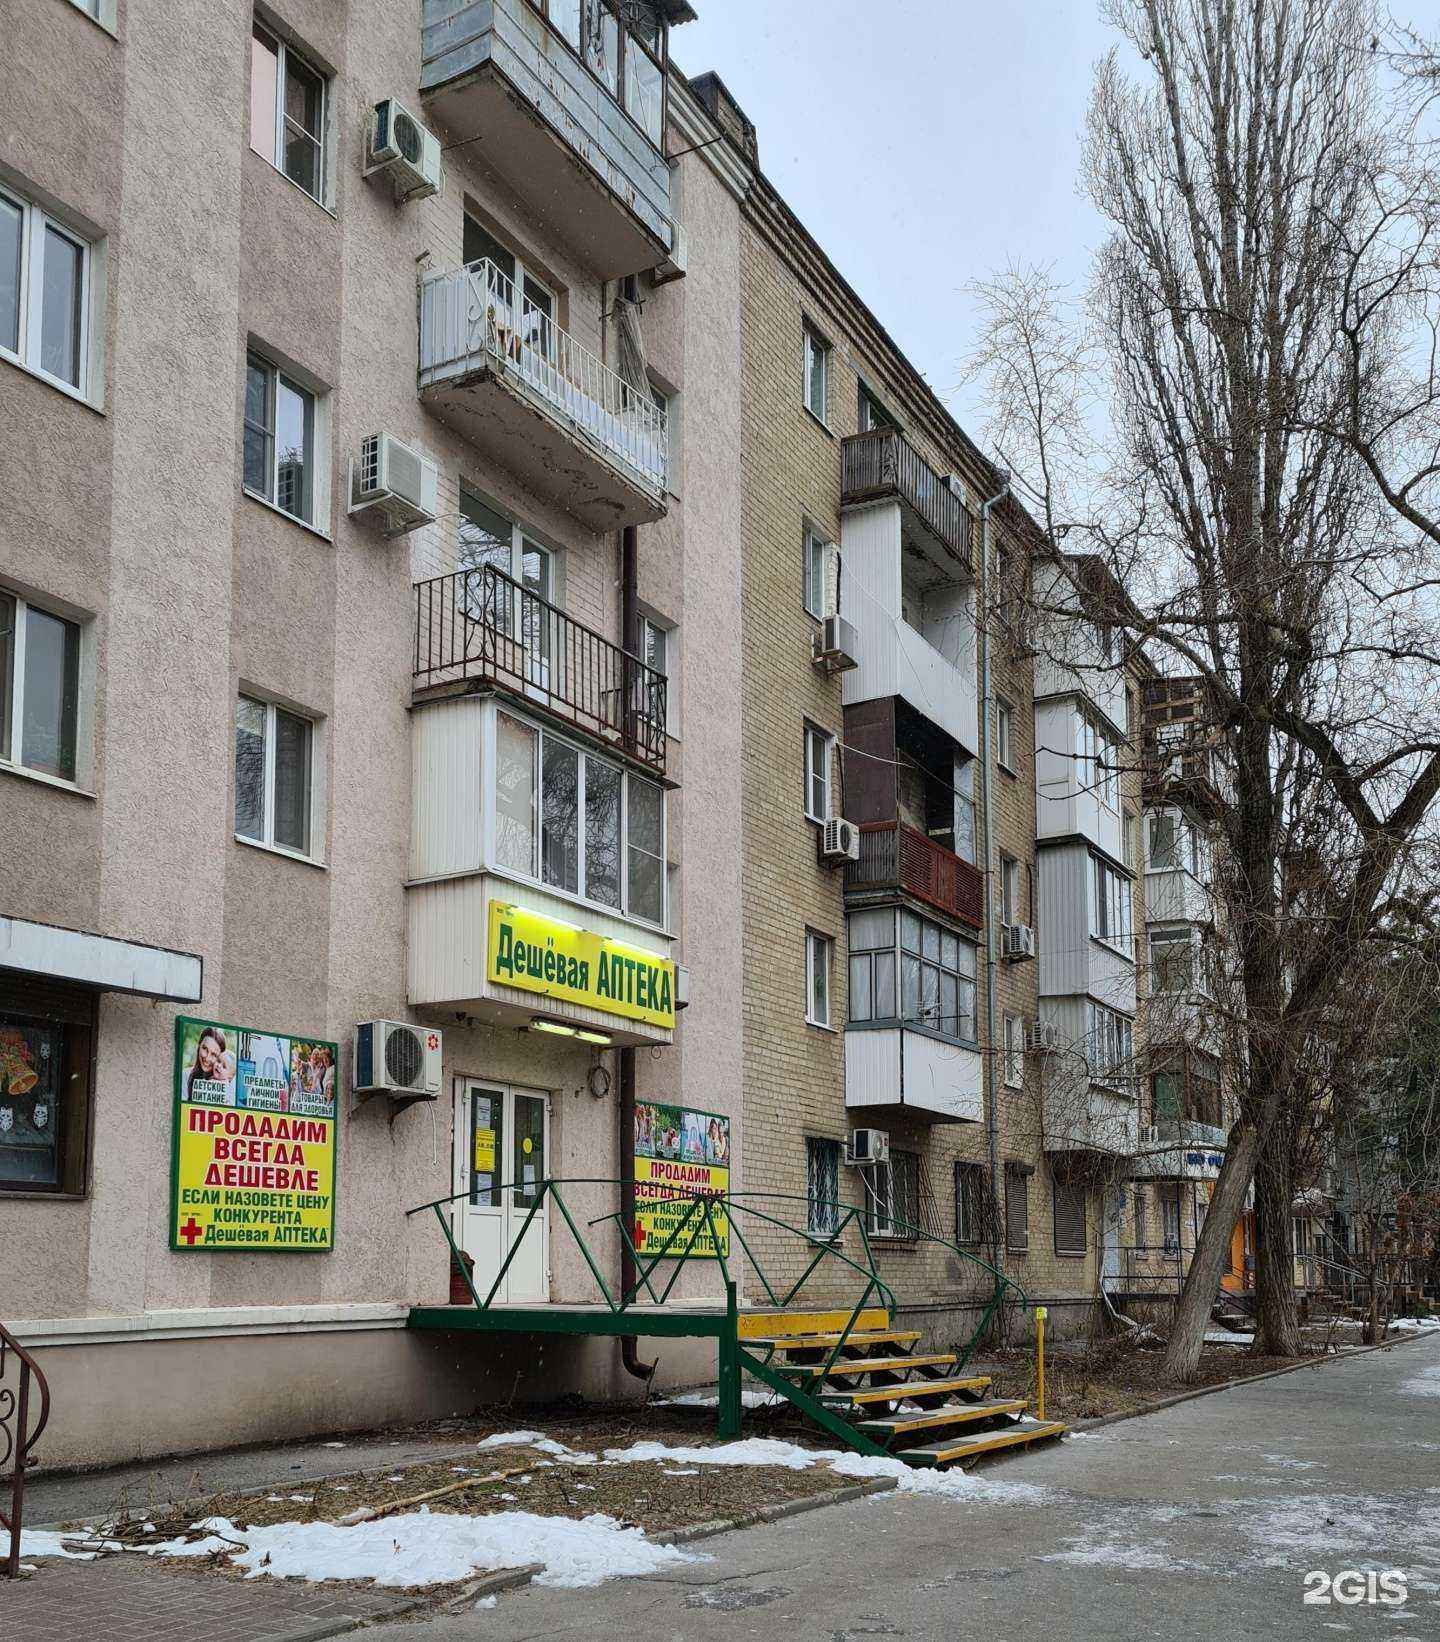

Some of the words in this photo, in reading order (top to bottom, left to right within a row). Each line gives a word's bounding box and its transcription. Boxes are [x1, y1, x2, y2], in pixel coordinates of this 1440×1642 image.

[496, 922, 590, 992] Дешёвая
[596, 950, 672, 1015] АПТЕКА
[193, 1079, 226, 1093] ДЕТСКОЕ
[244, 1075, 286, 1089] ПРЕДМЕТЫ
[192, 1090, 226, 1104] ПИТАНИЕ
[189, 1108, 327, 1144] ПРОДАДИМ
[214, 1137, 305, 1166] ВСЕГДА
[204, 1163, 318, 1191] ДЕШЕВЛЕ
[650, 1161, 711, 1184] ПРОДАДИМ
[182, 1188, 220, 1205] ЕСЛИ
[224, 1191, 293, 1209] НАЗОВЕТЕ
[296, 1194, 330, 1210] ЦЕНУ
[634, 1180, 674, 1200] ВСЕГДА
[213, 1208, 302, 1225] КОНКУРЕНТА
[660, 1201, 703, 1218] НАЗОВТЕ
[204, 1224, 269, 1244] Дешёвая
[273, 1226, 328, 1244] АПТЕКА
